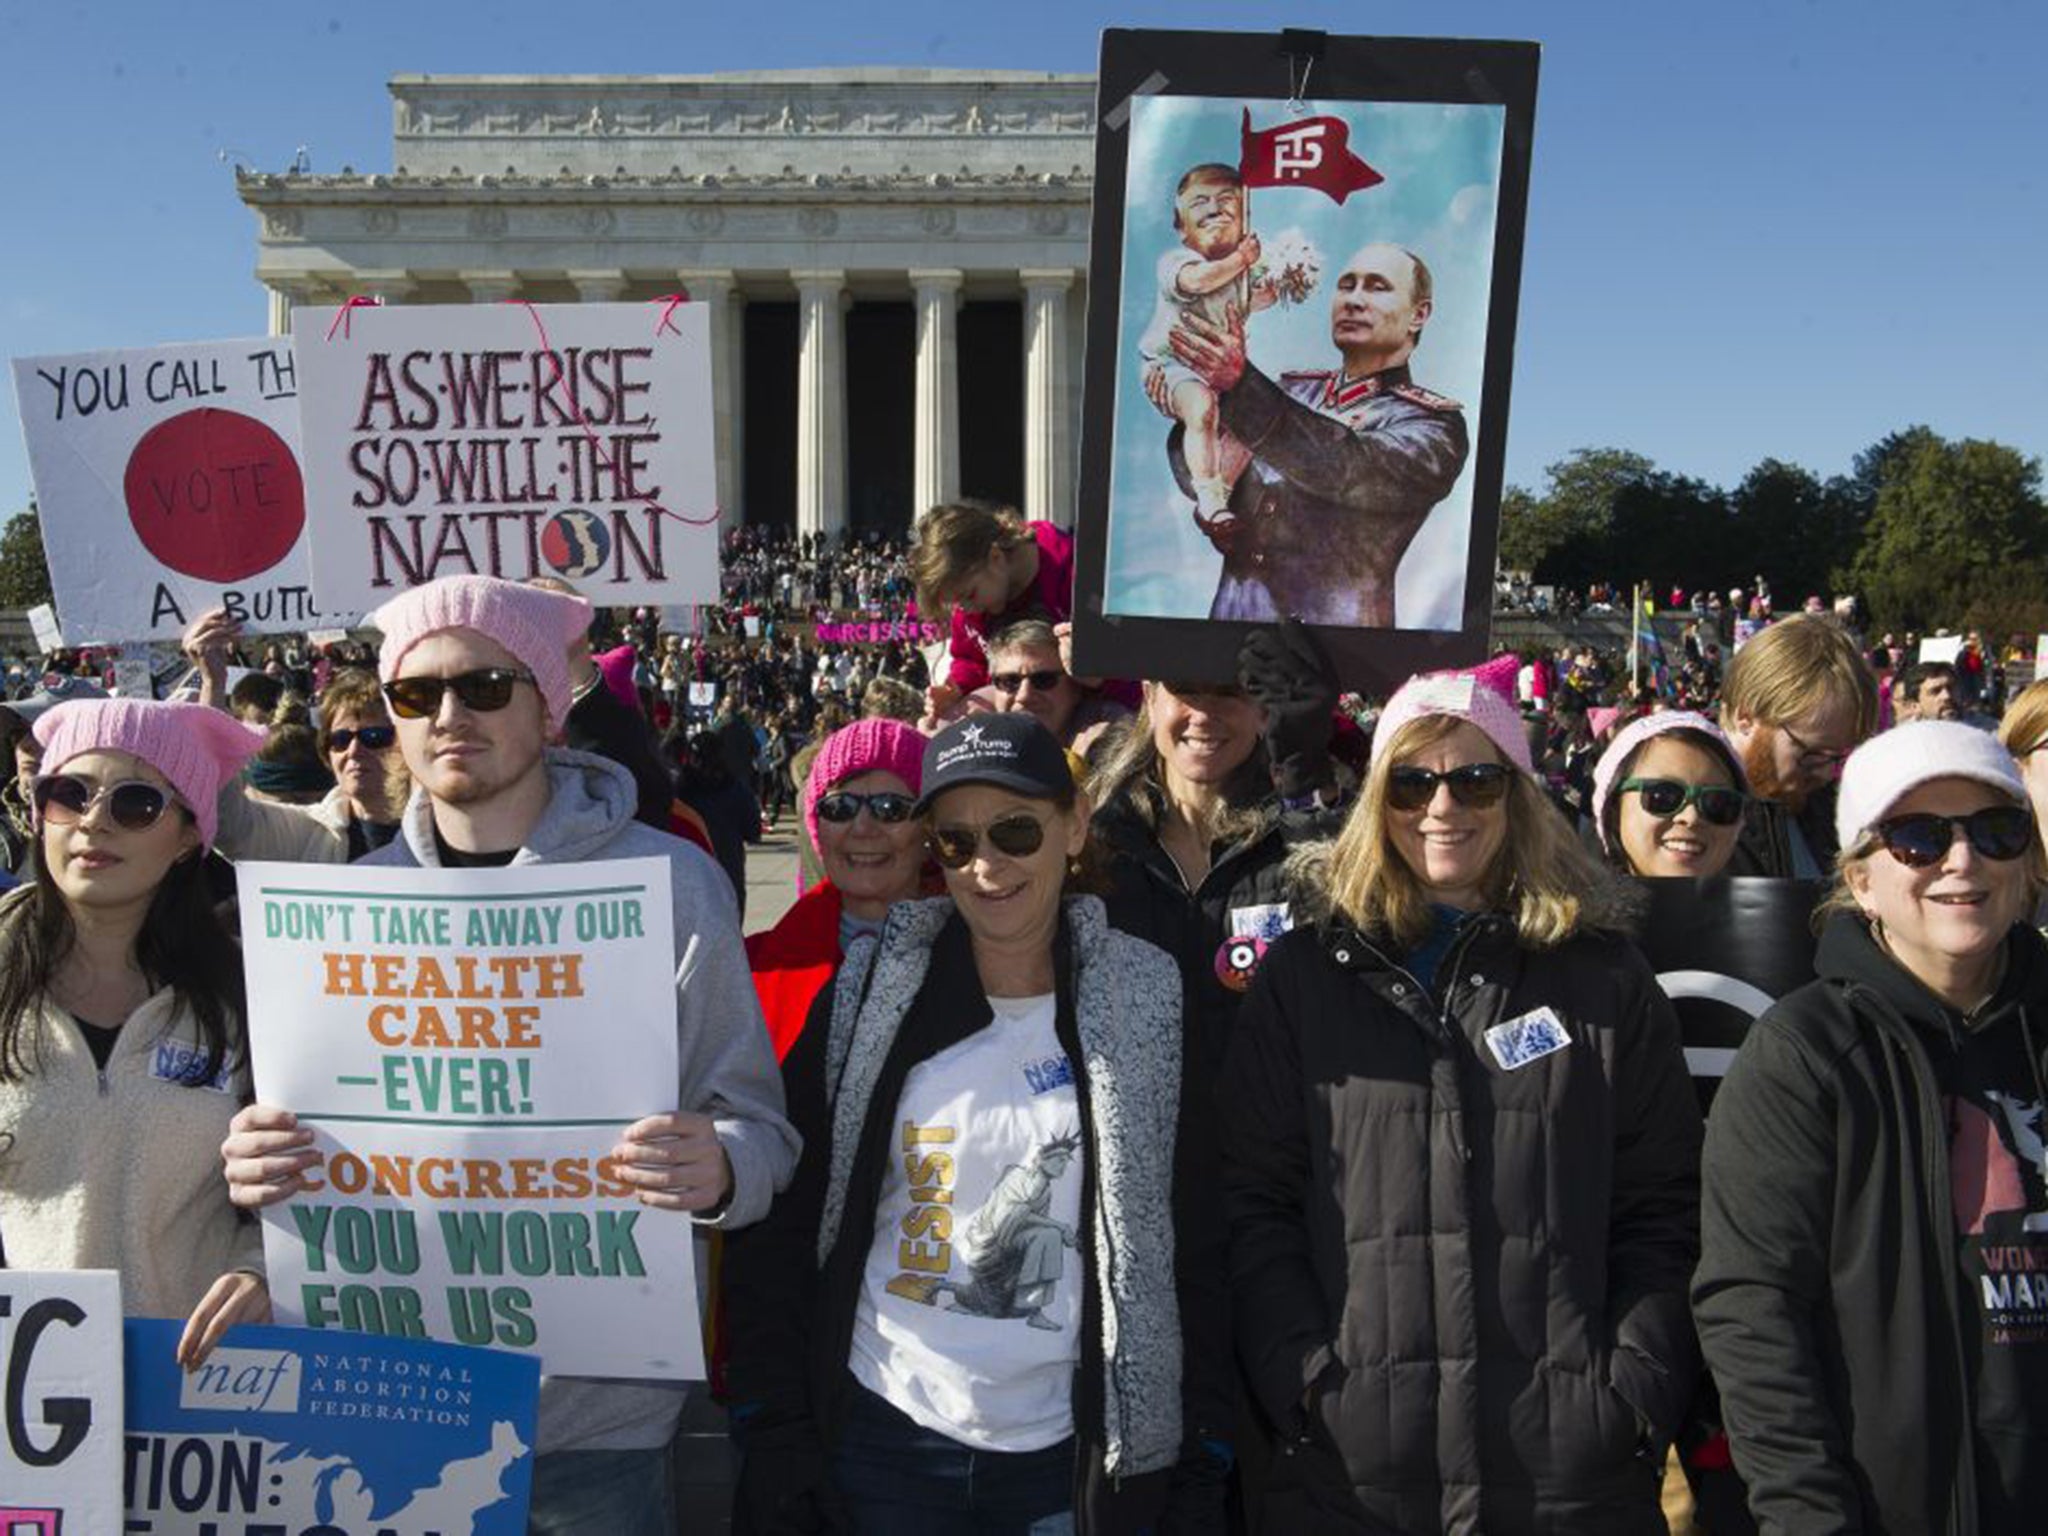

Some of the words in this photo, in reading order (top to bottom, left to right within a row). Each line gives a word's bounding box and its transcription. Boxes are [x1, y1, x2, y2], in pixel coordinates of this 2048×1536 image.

[37, 366, 129, 420] YOU
[146, 359, 227, 402] CALL
[151, 462, 281, 516] VOTE
[151, 582, 186, 628] A
[222, 585, 354, 623] BUTT
[972, 738, 1013, 751] Trump
[264, 901, 355, 942] DON'T
[368, 906, 451, 946] TAKE
[466, 906, 562, 947] AWAY
[575, 899, 645, 942] OUR
[323, 953, 584, 999] HEALTH
[367, 1004, 542, 1048] CARE
[298, 1152, 639, 1199] CONGRESS
[885, 1120, 957, 1307] RESIST
[290, 1205, 421, 1276] YOU
[438, 1209, 647, 1278] WORK
[301, 1283, 433, 1340] FOR
[446, 1285, 538, 1348] US
[0, 1294, 93, 1467] G
[197, 1351, 294, 1411] naf
[310, 1378, 472, 1406] ABORTION
[314, 1353, 472, 1384] NATIONAL
[309, 1401, 470, 1428] FEDERATION
